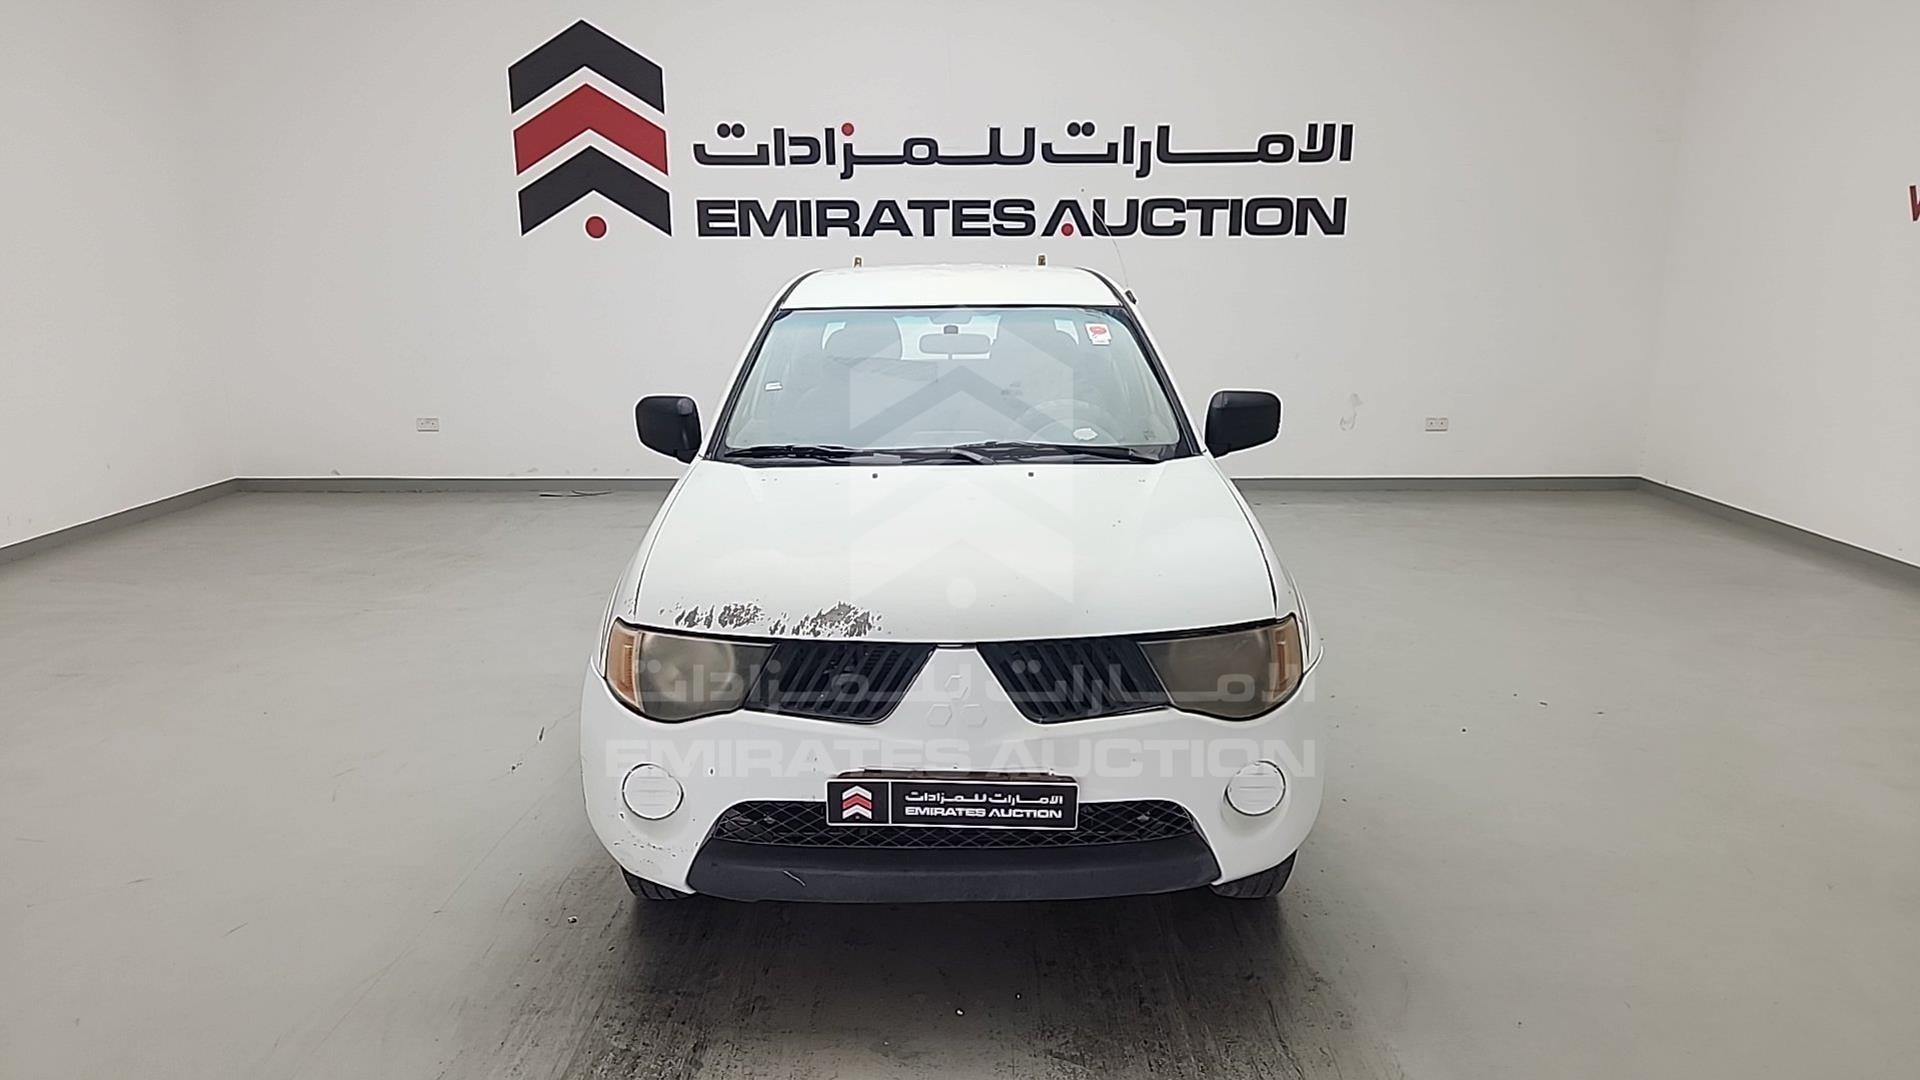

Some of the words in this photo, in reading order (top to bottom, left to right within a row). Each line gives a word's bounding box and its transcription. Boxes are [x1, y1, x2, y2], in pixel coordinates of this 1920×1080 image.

[696, 198, 1036, 237] EMIRATES
[1040, 197, 1347, 237] AUCTION
[904, 806, 986, 817] EMIRATES
[988, 808, 1062, 818] AUCTION
